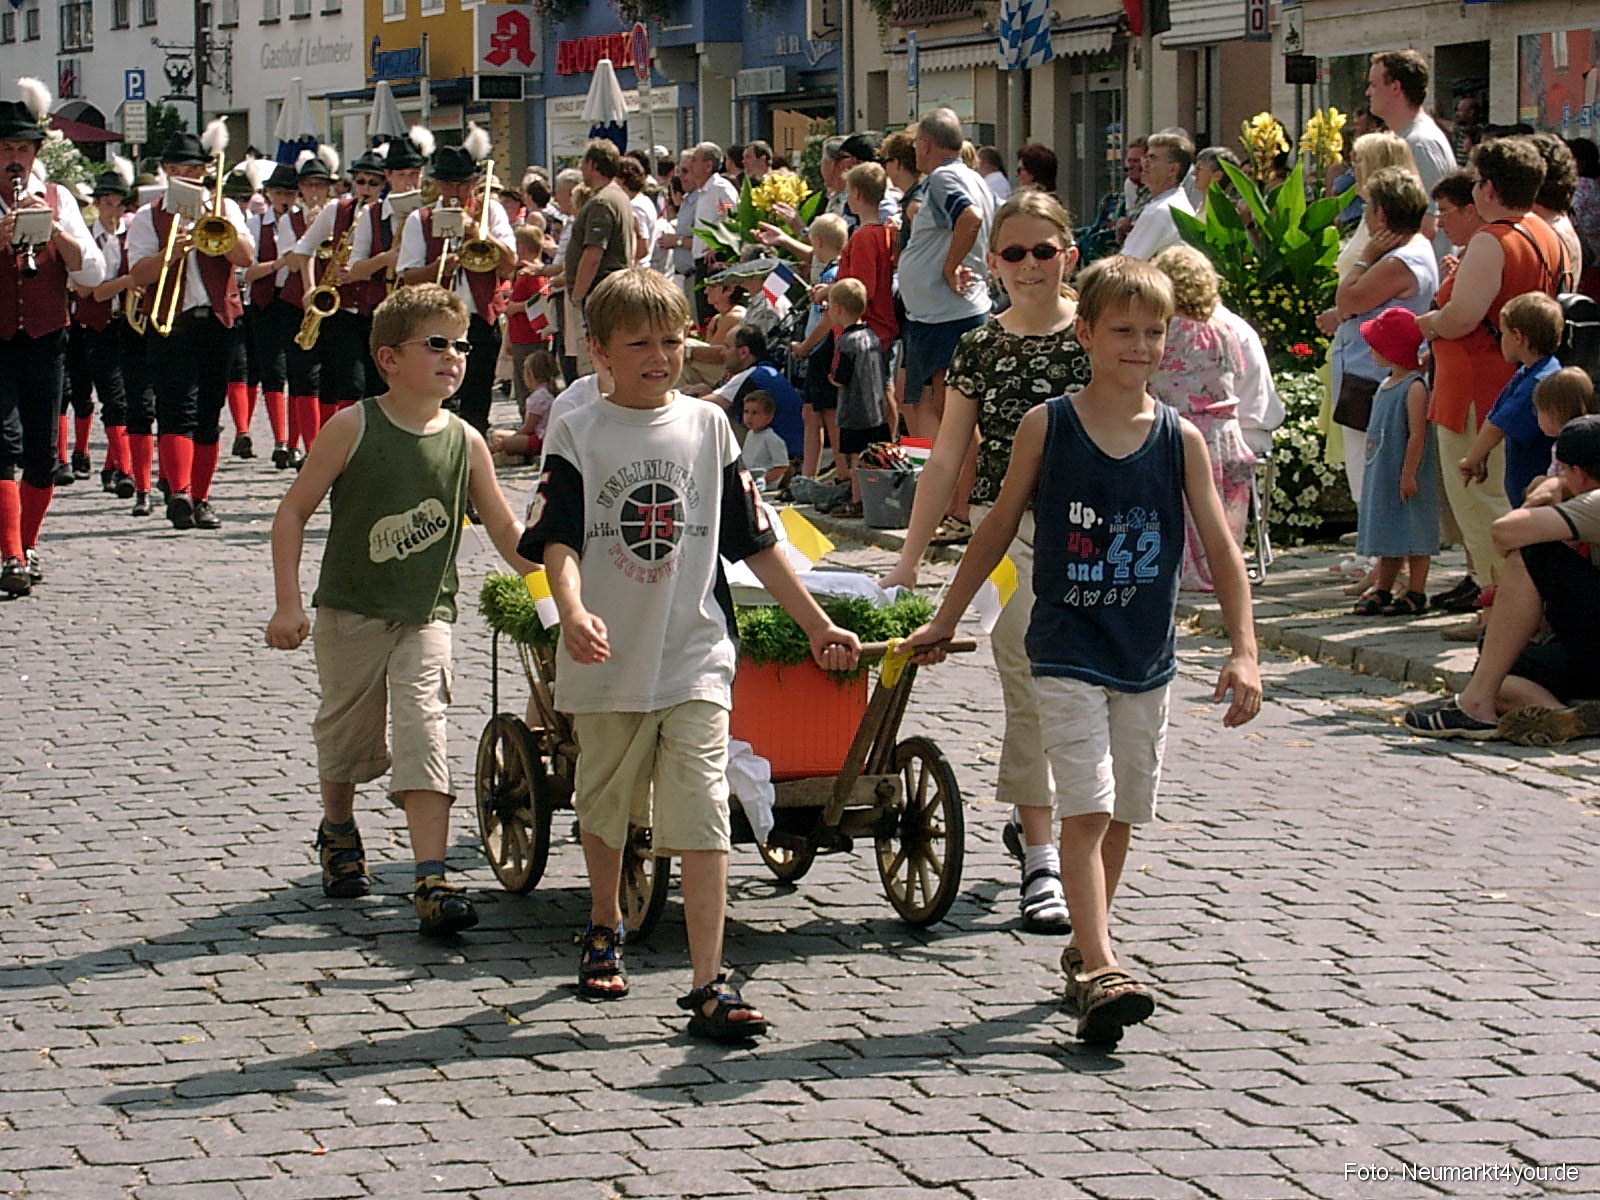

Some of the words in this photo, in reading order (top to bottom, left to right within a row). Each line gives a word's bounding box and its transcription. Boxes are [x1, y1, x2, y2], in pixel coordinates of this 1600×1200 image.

[260, 37, 303, 70] Gasthof
[556, 31, 655, 75] APOTHEK
[129, 72, 141, 97] P
[597, 459, 700, 509] UNLIMITED
[637, 504, 673, 539] 75
[1069, 501, 1103, 529] Up.
[396, 515, 447, 555] FEELING
[1068, 532, 1101, 558] Up.
[1067, 560, 1104, 581] and
[1107, 533, 1161, 578] 42
